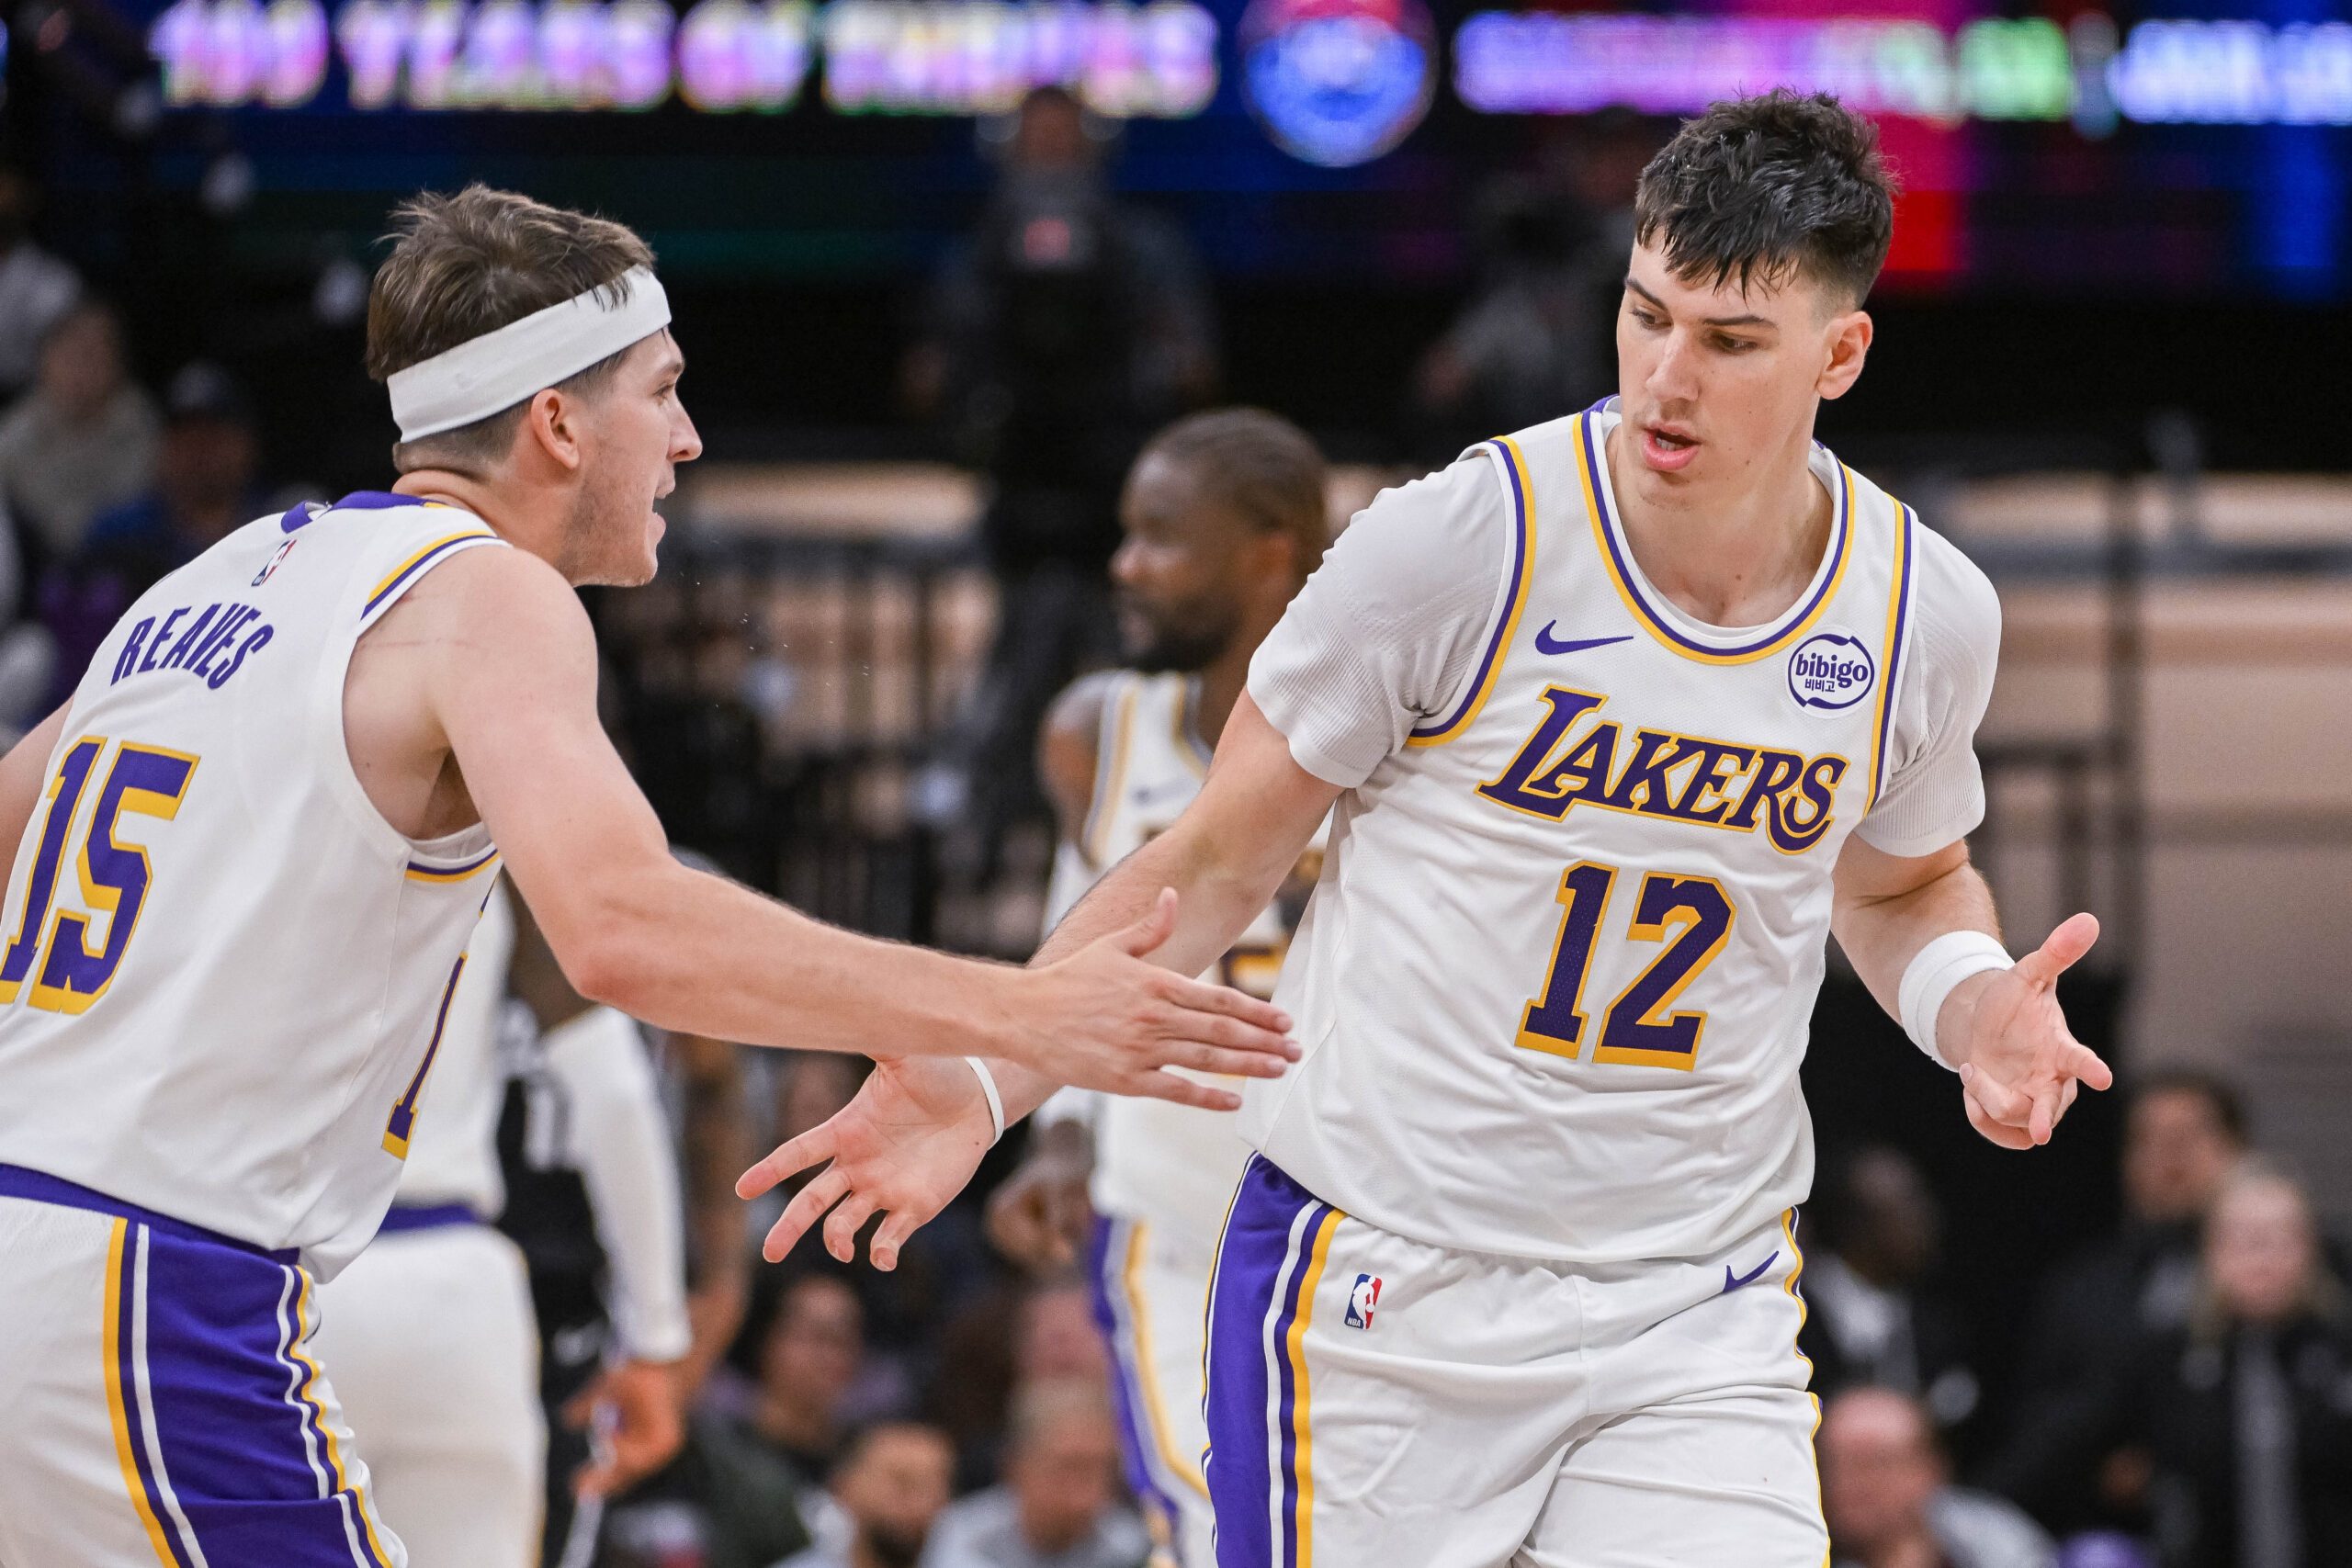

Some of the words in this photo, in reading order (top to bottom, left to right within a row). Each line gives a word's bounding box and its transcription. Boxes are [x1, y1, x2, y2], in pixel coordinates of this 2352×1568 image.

[110, 603, 274, 690] REAVES
[1795, 652, 1869, 688] bibigo
[1804, 678, 1836, 693] 비비고
[1474, 683, 1851, 855] LAKERS
[0, 736, 201, 1016] 15
[1514, 860, 1737, 1072] 12
[1347, 1316, 1362, 1327] NBA
